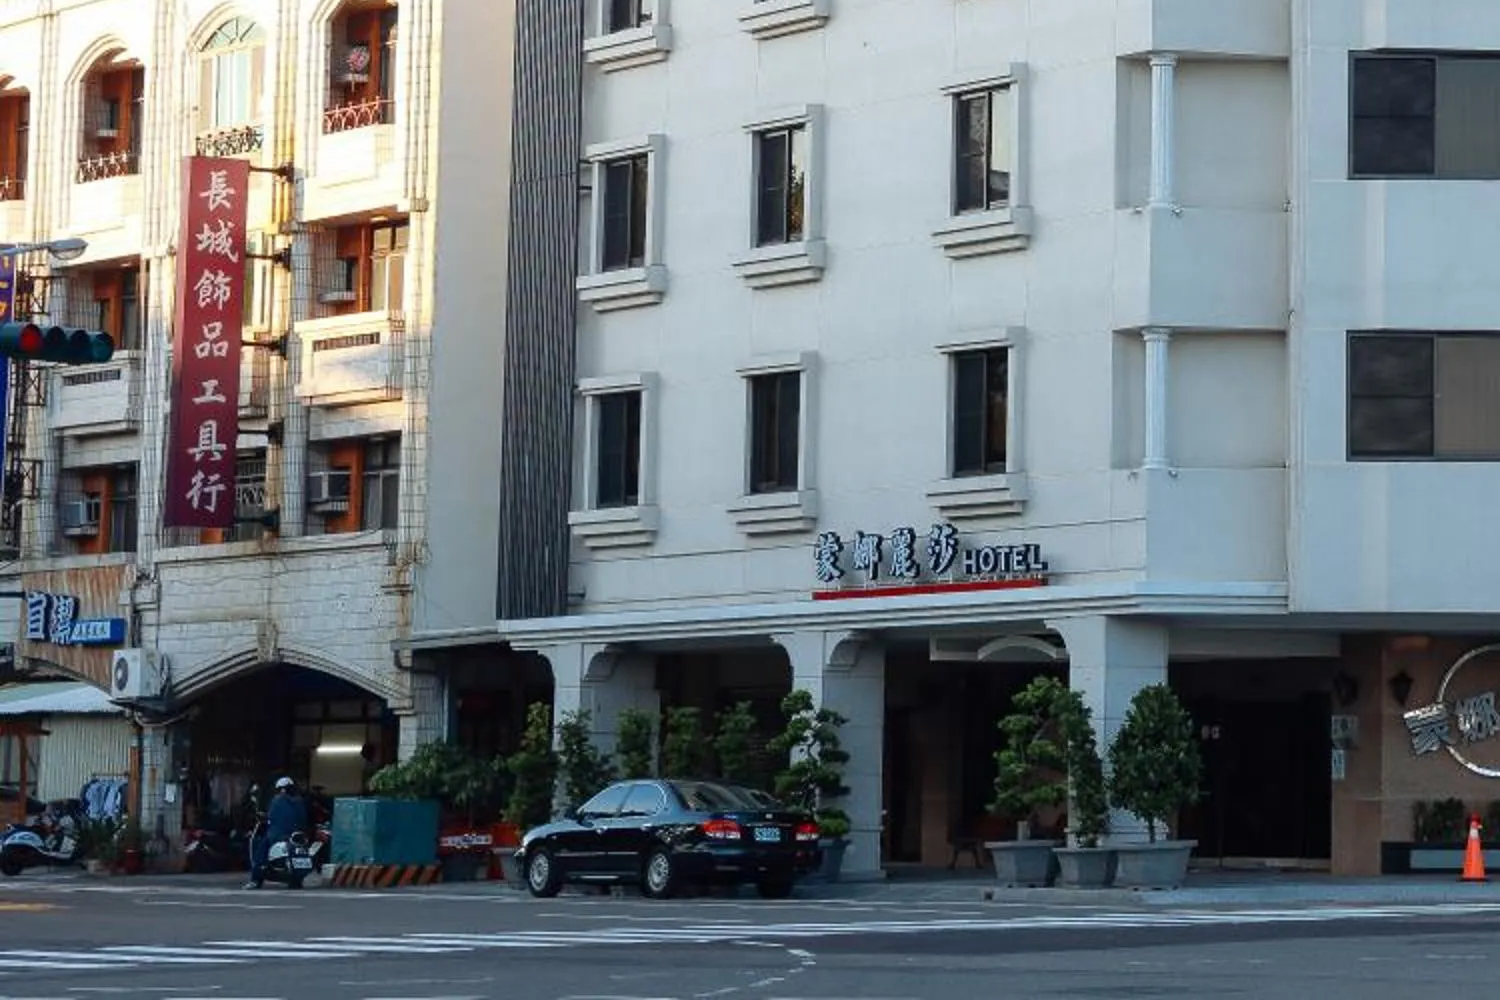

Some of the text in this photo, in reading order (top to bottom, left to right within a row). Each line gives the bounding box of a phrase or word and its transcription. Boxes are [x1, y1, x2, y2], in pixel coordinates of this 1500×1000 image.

[185, 169, 239, 514] 長城飾品工具行
[814, 523, 1049, 582] 蒙娜麗莎 HOTEL
